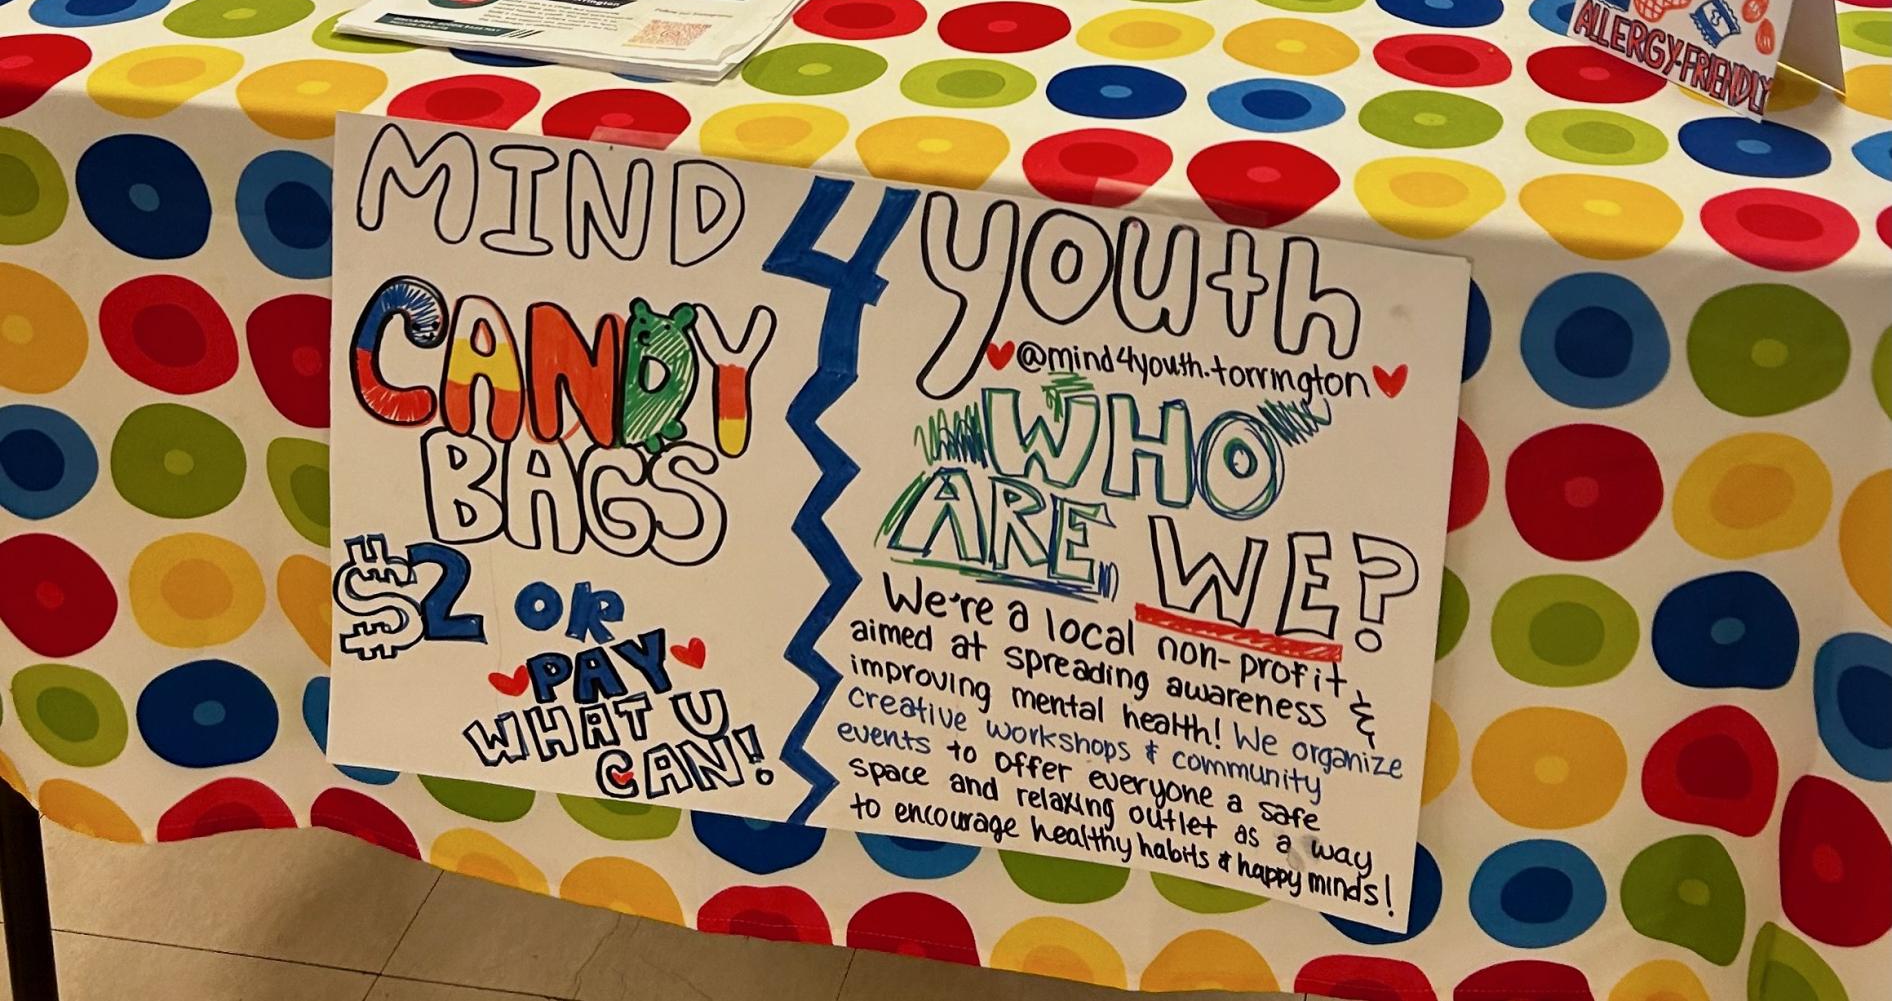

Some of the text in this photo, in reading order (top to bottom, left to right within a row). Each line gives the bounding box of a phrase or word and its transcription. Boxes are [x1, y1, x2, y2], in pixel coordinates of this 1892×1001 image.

[356, 124, 746, 267] MIND
[761, 175, 921, 382] 4
[349, 277, 778, 458] CANDY
[1016, 340, 1371, 402] @mind4youth.torrington
[420, 426, 727, 566] BAGS
[978, 387, 1284, 521] WHO
[333, 534, 488, 661] $2
[882, 571, 995, 627] We're
[1007, 599, 1030, 633] a
[1045, 607, 1135, 657] local
[886, 466, 1420, 652] ARE WE?
[526, 627, 675, 703] PAY
[850, 618, 933, 652] aimed
[951, 630, 989, 662] at
[1004, 646, 1150, 702] spreading
[1166, 675, 1328, 729] awareness
[850, 654, 1405, 780] improving mental health! We organize
[463, 689, 732, 768] WHAT U
[596, 724, 775, 800] CAN!
[837, 721, 932, 755] events
[946, 740, 979, 764] to
[1088, 769, 1214, 810] everyone
[1226, 793, 1244, 815] a
[1257, 800, 1321, 832] safe
[985, 719, 1132, 764] workshops
[1172, 750, 1323, 806] community
[848, 757, 1374, 880] space and relaxing outlet as a way
[849, 791, 881, 820] to
[894, 801, 1020, 843] encourage
[1030, 815, 1133, 863] healthy
[1136, 831, 1210, 870] habits
[1237, 851, 1302, 898] happy
[1307, 869, 1396, 918] minds!
